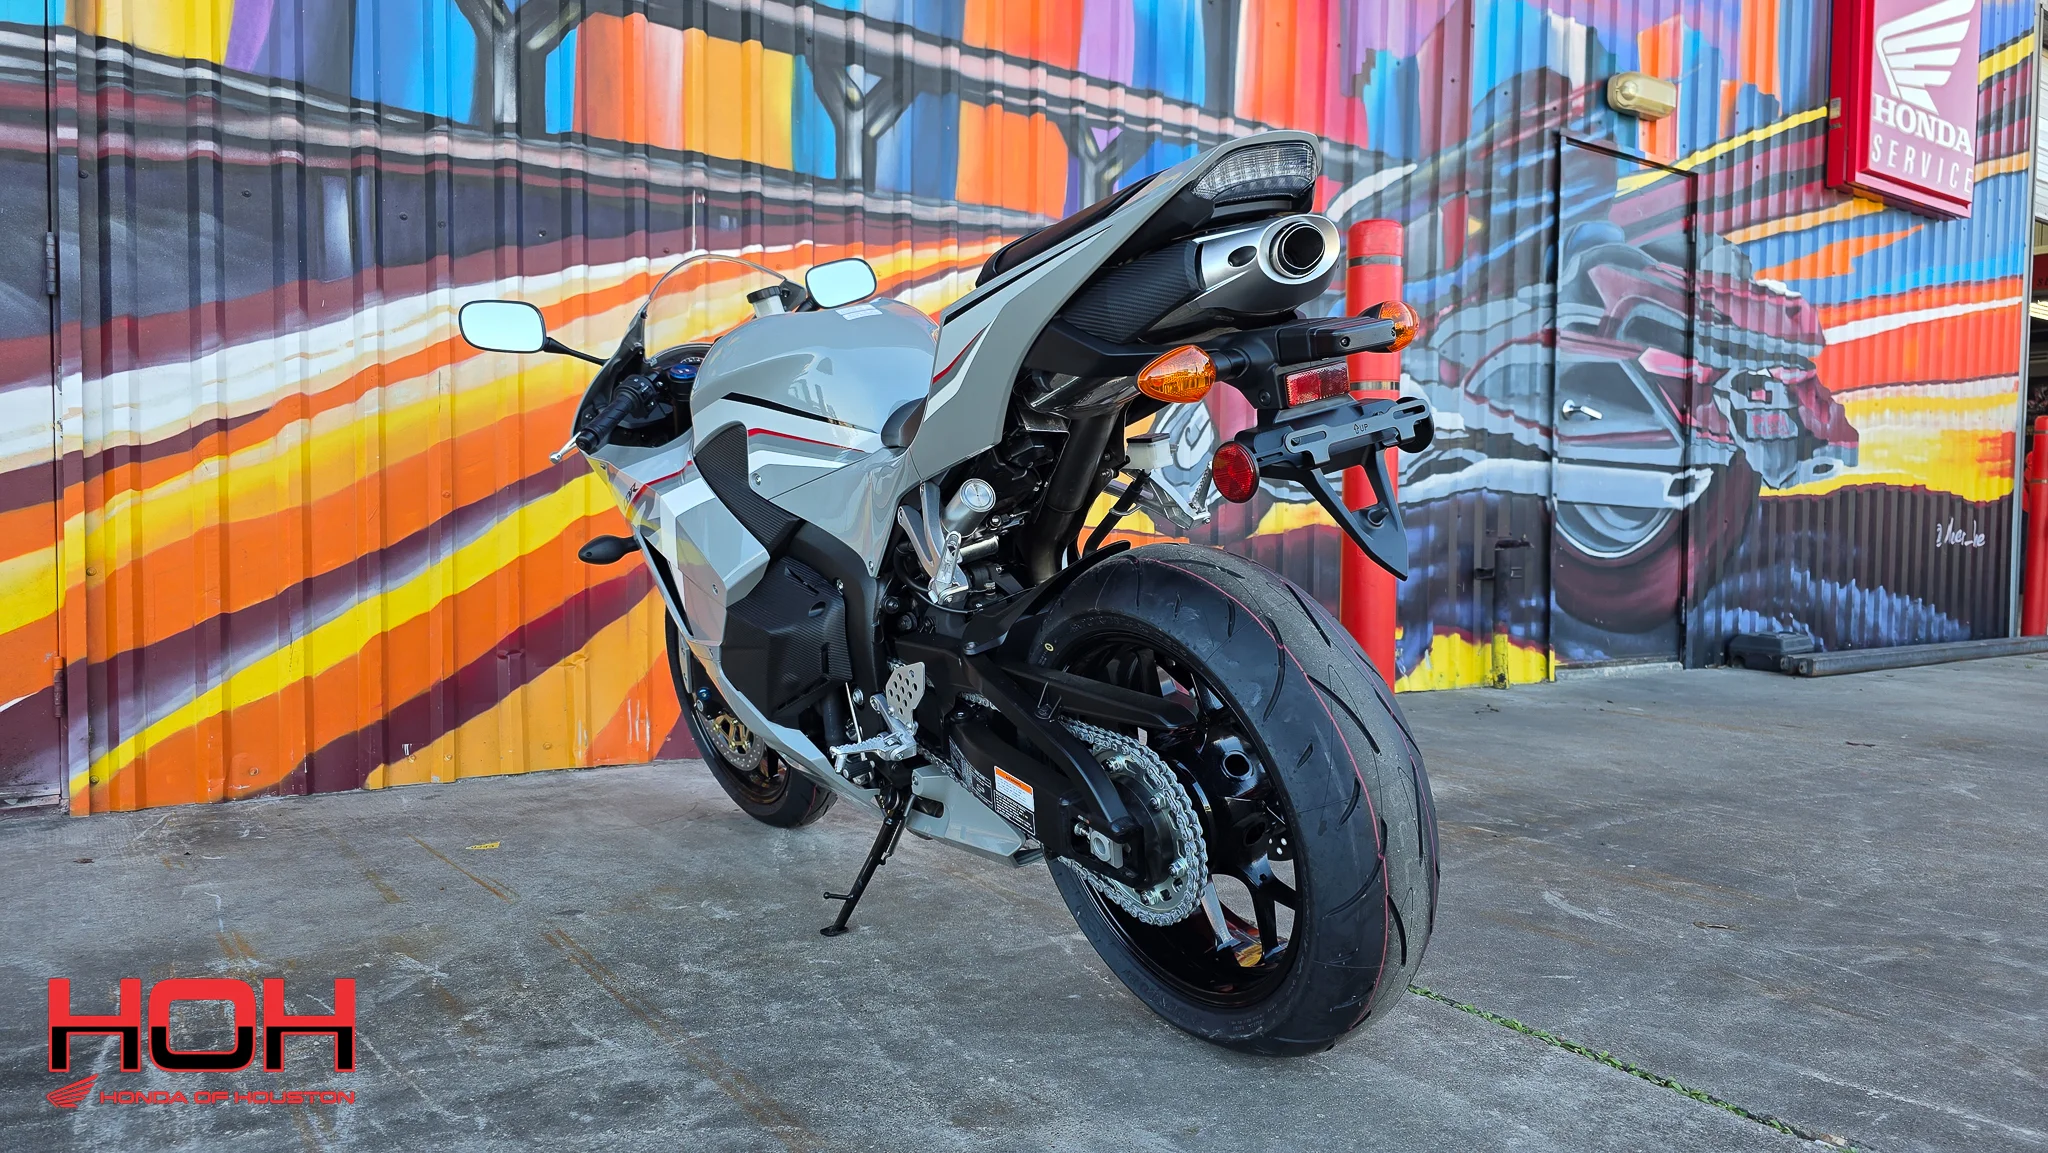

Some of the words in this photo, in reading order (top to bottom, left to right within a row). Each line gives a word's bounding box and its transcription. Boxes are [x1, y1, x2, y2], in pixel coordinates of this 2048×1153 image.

[1873, 94, 1974, 157] HONDA
[1872, 135, 1973, 193] SERVICE
[1360, 424, 1368, 432] UP
